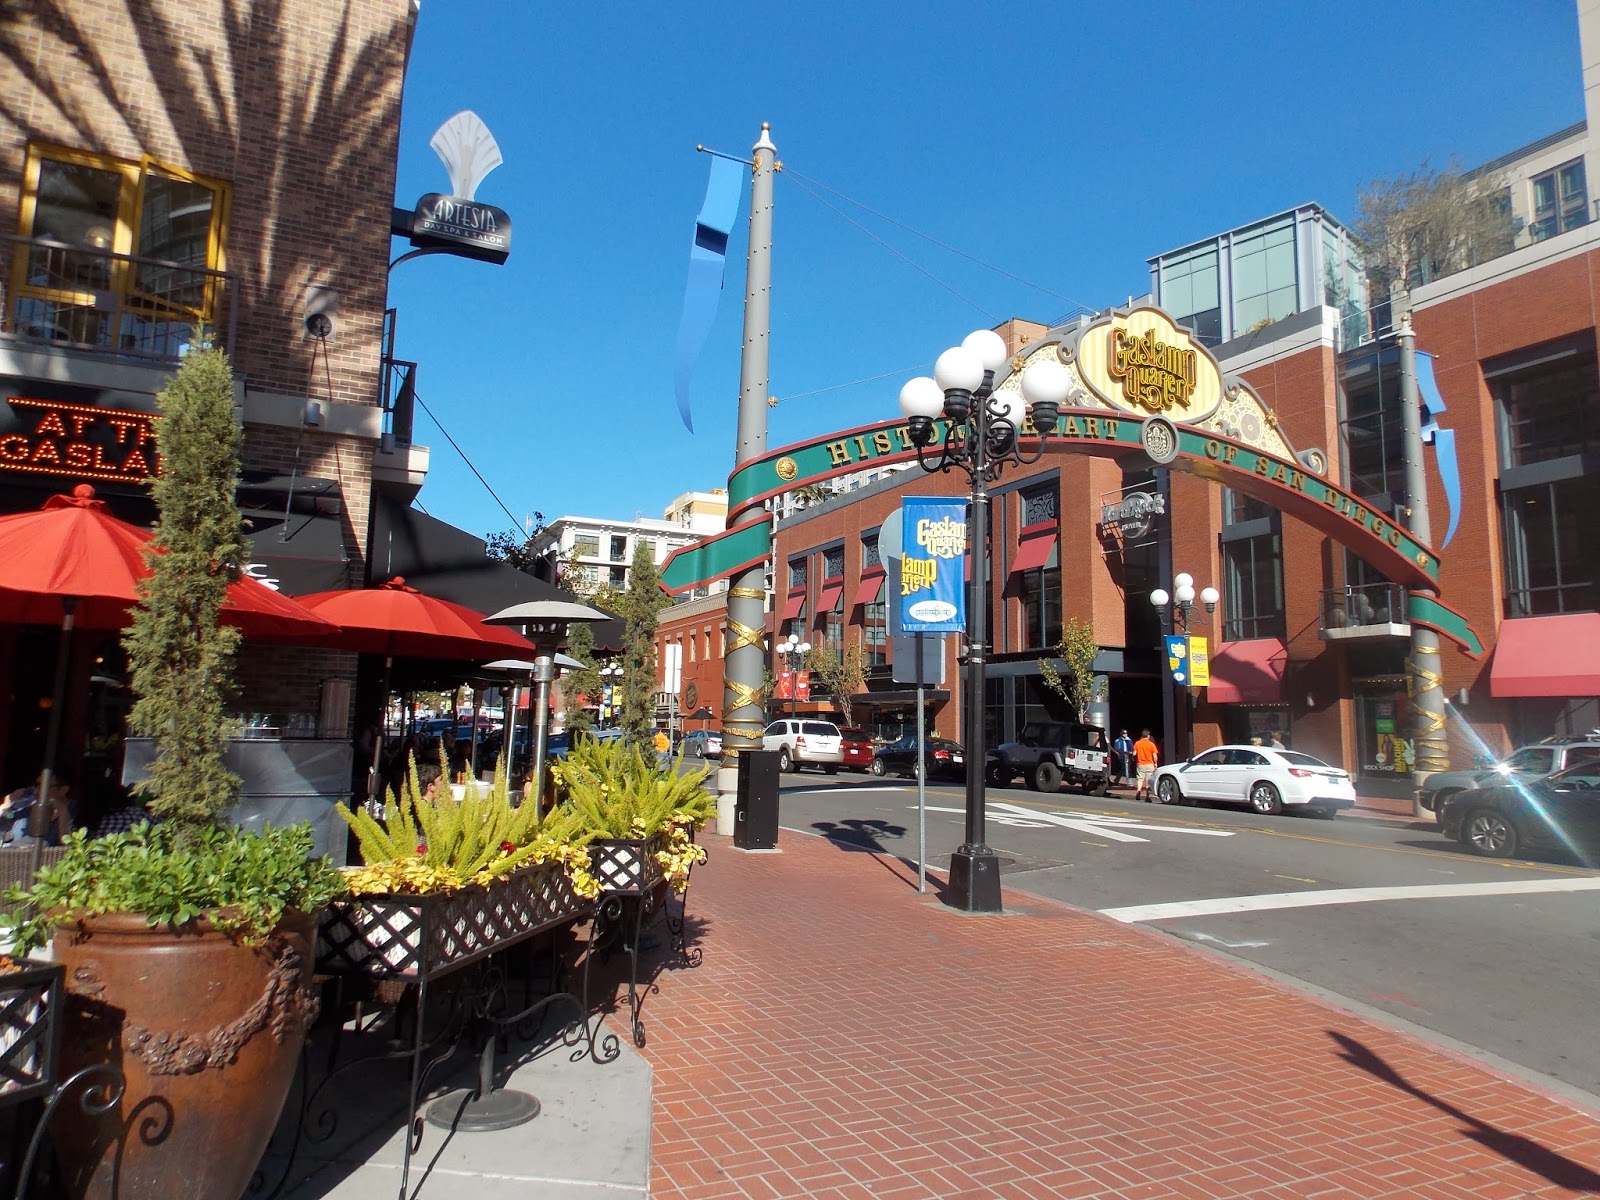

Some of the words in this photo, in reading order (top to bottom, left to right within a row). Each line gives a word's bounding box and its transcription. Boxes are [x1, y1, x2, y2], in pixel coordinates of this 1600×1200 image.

[424, 221, 441, 232] DAY
[443, 225, 461, 235] SPA
[464, 230, 471, 238] &
[472, 231, 503, 244] SALON
[432, 199, 498, 233] ARTESIA
[1107, 327, 1197, 392] Gaslamp
[1125, 365, 1188, 410] Quarter
[36, 411, 95, 437] AT
[109, 419, 160, 446] TH
[0, 434, 166, 475] GASLA
[1205, 439, 1239, 464] OF
[1255, 456, 1307, 492] SAN
[1324, 487, 1403, 547] DIEGO
